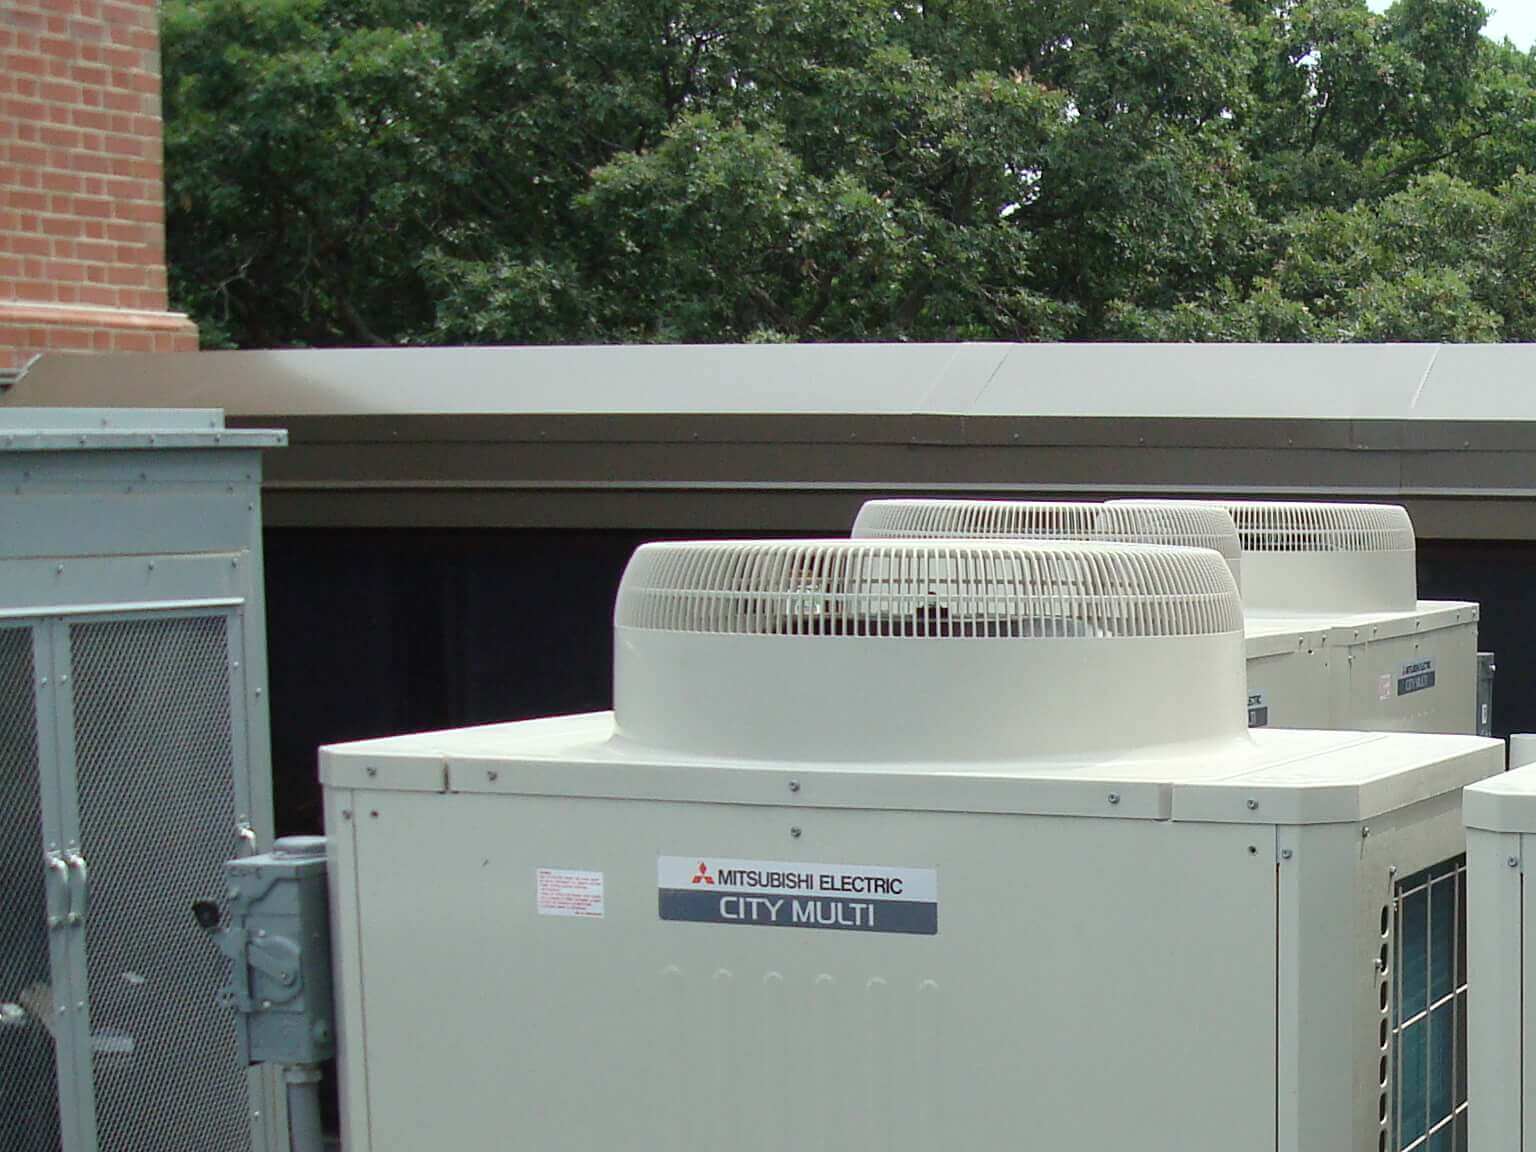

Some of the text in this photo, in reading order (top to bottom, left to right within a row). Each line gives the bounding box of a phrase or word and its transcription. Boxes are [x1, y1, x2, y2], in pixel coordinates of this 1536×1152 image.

[718, 869, 903, 895] MITSUBISHI ELECTRIC
[720, 897, 875, 927] CITY MULTI
